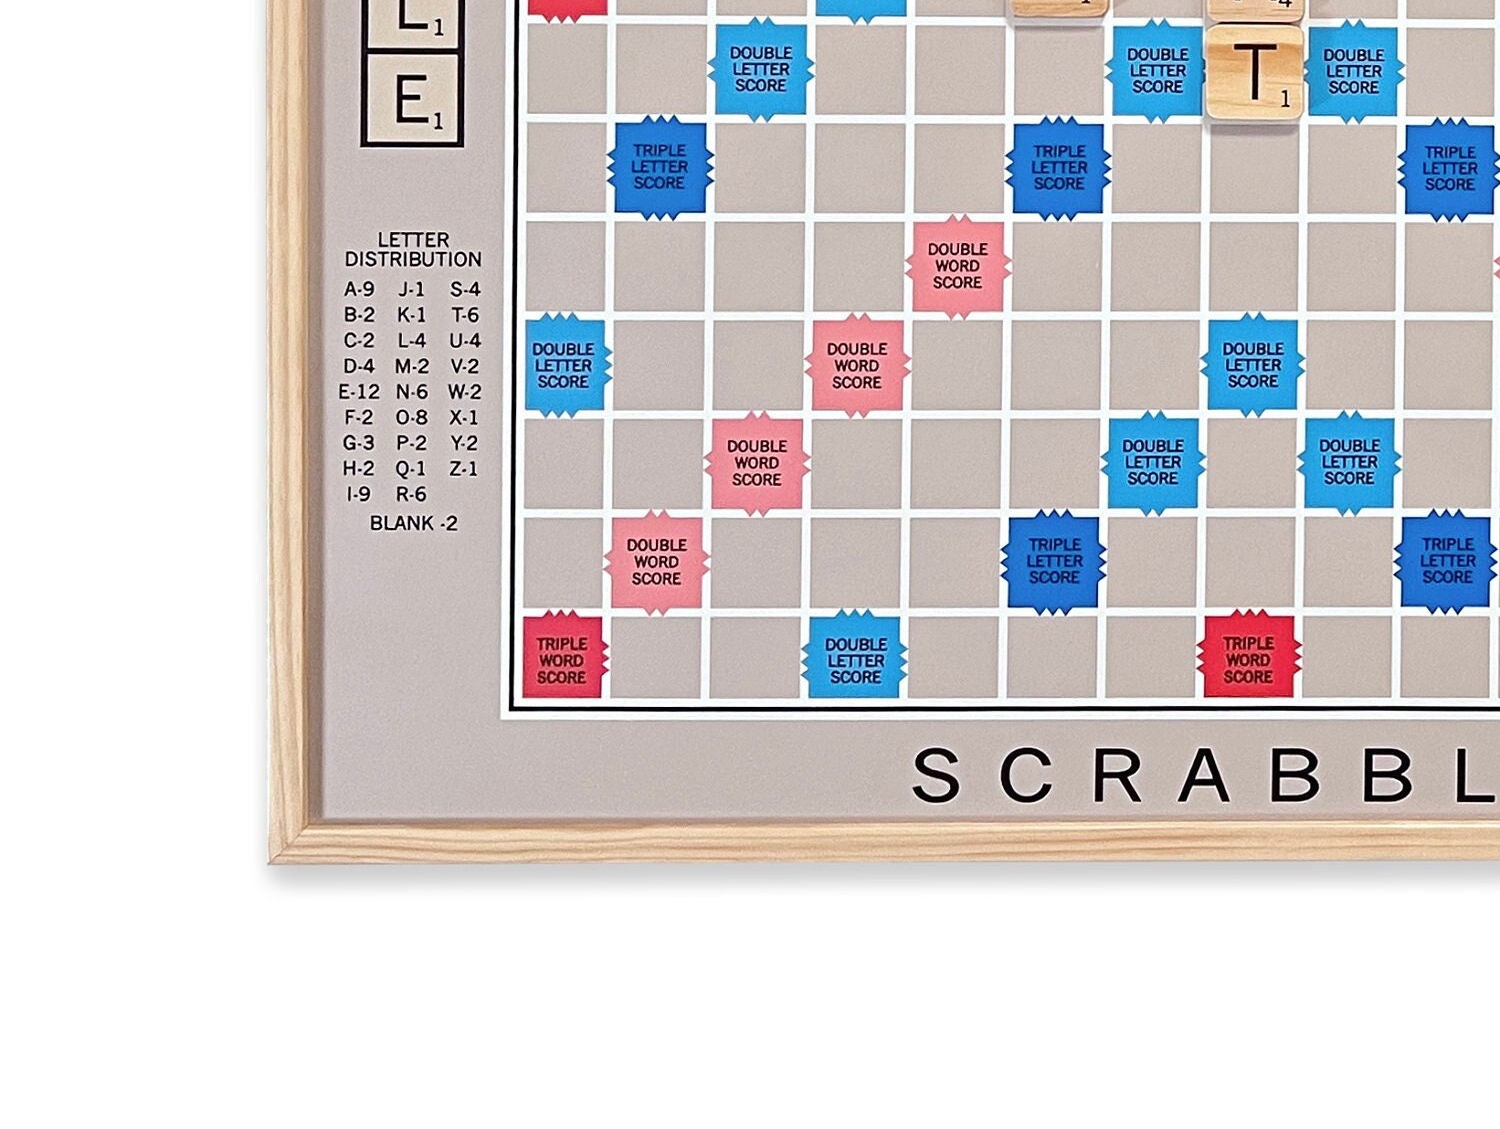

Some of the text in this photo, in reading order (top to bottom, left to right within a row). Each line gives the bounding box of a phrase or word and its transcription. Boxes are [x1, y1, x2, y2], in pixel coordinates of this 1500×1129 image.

[730, 46, 793, 60] DOUBLE
[1323, 48, 1385, 62] DOUBLE
[733, 62, 790, 76] LETTER
[1326, 64, 1382, 78] LETTER
[735, 78, 787, 92] SCORE
[1328, 80, 1379, 95] SCORE
[378, 232, 450, 248] LETTER
[928, 242, 988, 256] DOUBLE
[346, 251, 482, 267] DISTRIBUTION
[935, 259, 980, 273] WORD
[344, 281, 482, 298] A-9 J-1 S-4
[933, 275, 983, 290] SCORE
[345, 307, 480, 323] B-2 K-1 T-6
[345, 332, 482, 349] C-2 L-4 U-4
[827, 342, 888, 356] DOUBLE
[1223, 342, 1284, 356] DOUBLE
[345, 358, 479, 375] D-4 M-2 V-2
[834, 359, 880, 373] WORD
[1225, 358, 1282, 372] LETTER
[832, 375, 882, 390] SCORE
[1228, 374, 1279, 388] SCORE
[339, 384, 482, 400] E-12 N-6 W-2
[346, 409, 478, 426] F-2 O-8 X-1
[343, 435, 478, 451] G-3 P-2 Y-2
[727, 439, 788, 453] DOUBLE
[1319, 438, 1381, 453] DOUBLE
[734, 456, 780, 470] WORD
[1322, 454, 1378, 469] LETTER
[344, 461, 478, 480] H-2 Q-1 Z-1
[732, 472, 782, 487] SCORE
[1324, 471, 1375, 485] SCORE
[348, 486, 427, 503] I-9 R-6
[371, 515, 434, 531] BLANK
[627, 538, 687, 552] DOUBLE
[634, 555, 679, 569] WORD
[632, 571, 682, 586] SCORE
[537, 637, 588, 651] TRIPLE
[825, 637, 888, 652] DOUBLE
[539, 654, 584, 668] WORD
[828, 653, 885, 668] LETTER
[537, 670, 586, 684] SCORE
[830, 670, 882, 684] SCORE
